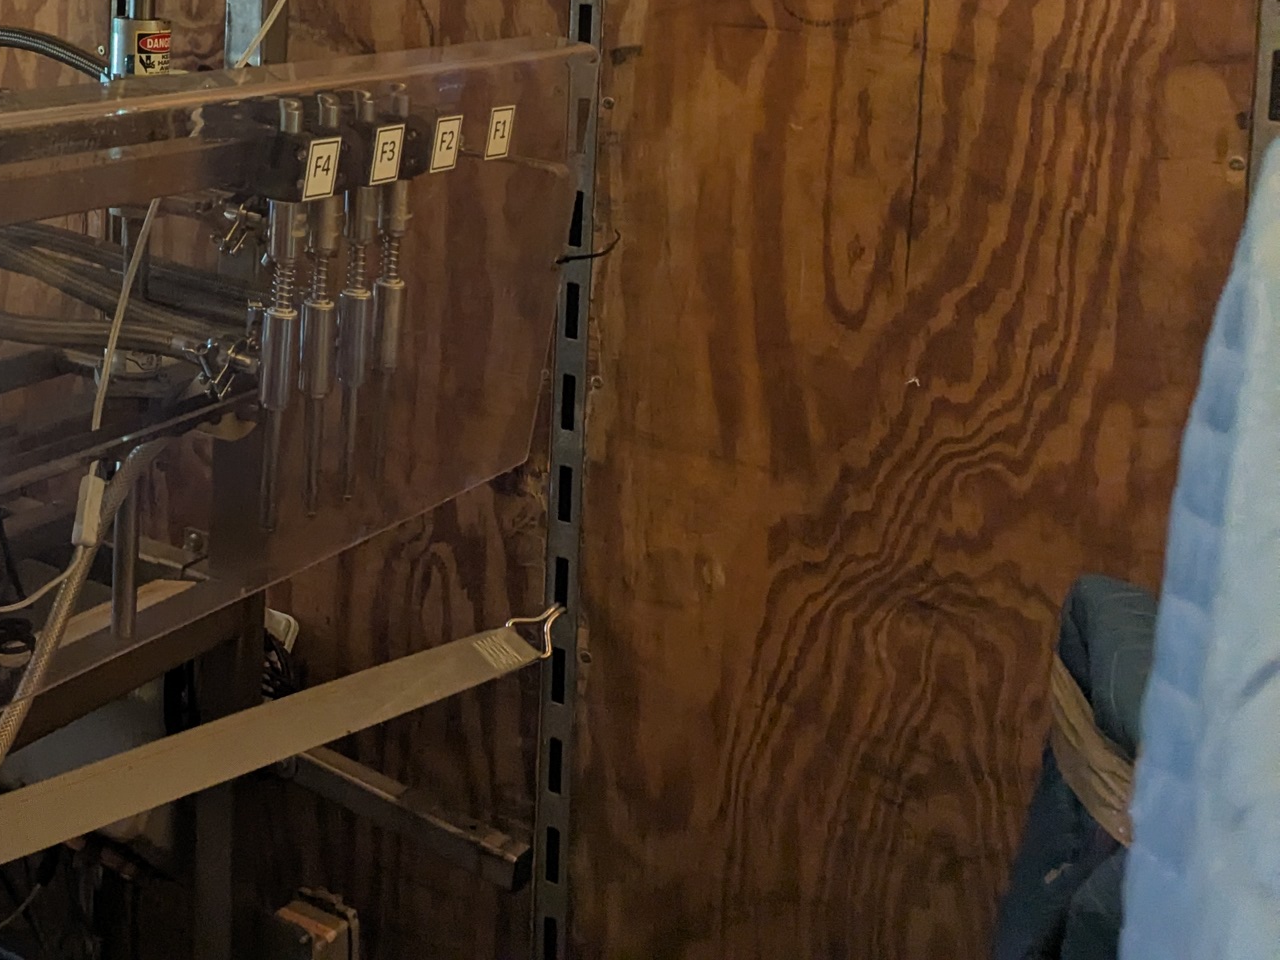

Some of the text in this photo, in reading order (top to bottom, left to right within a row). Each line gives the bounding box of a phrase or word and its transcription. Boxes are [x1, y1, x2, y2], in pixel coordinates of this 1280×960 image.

[146, 37, 170, 49] DANG
[493, 119, 507, 140] F1
[379, 140, 396, 163] F3
[439, 130, 454, 152] F2
[313, 154, 331, 178] F4
